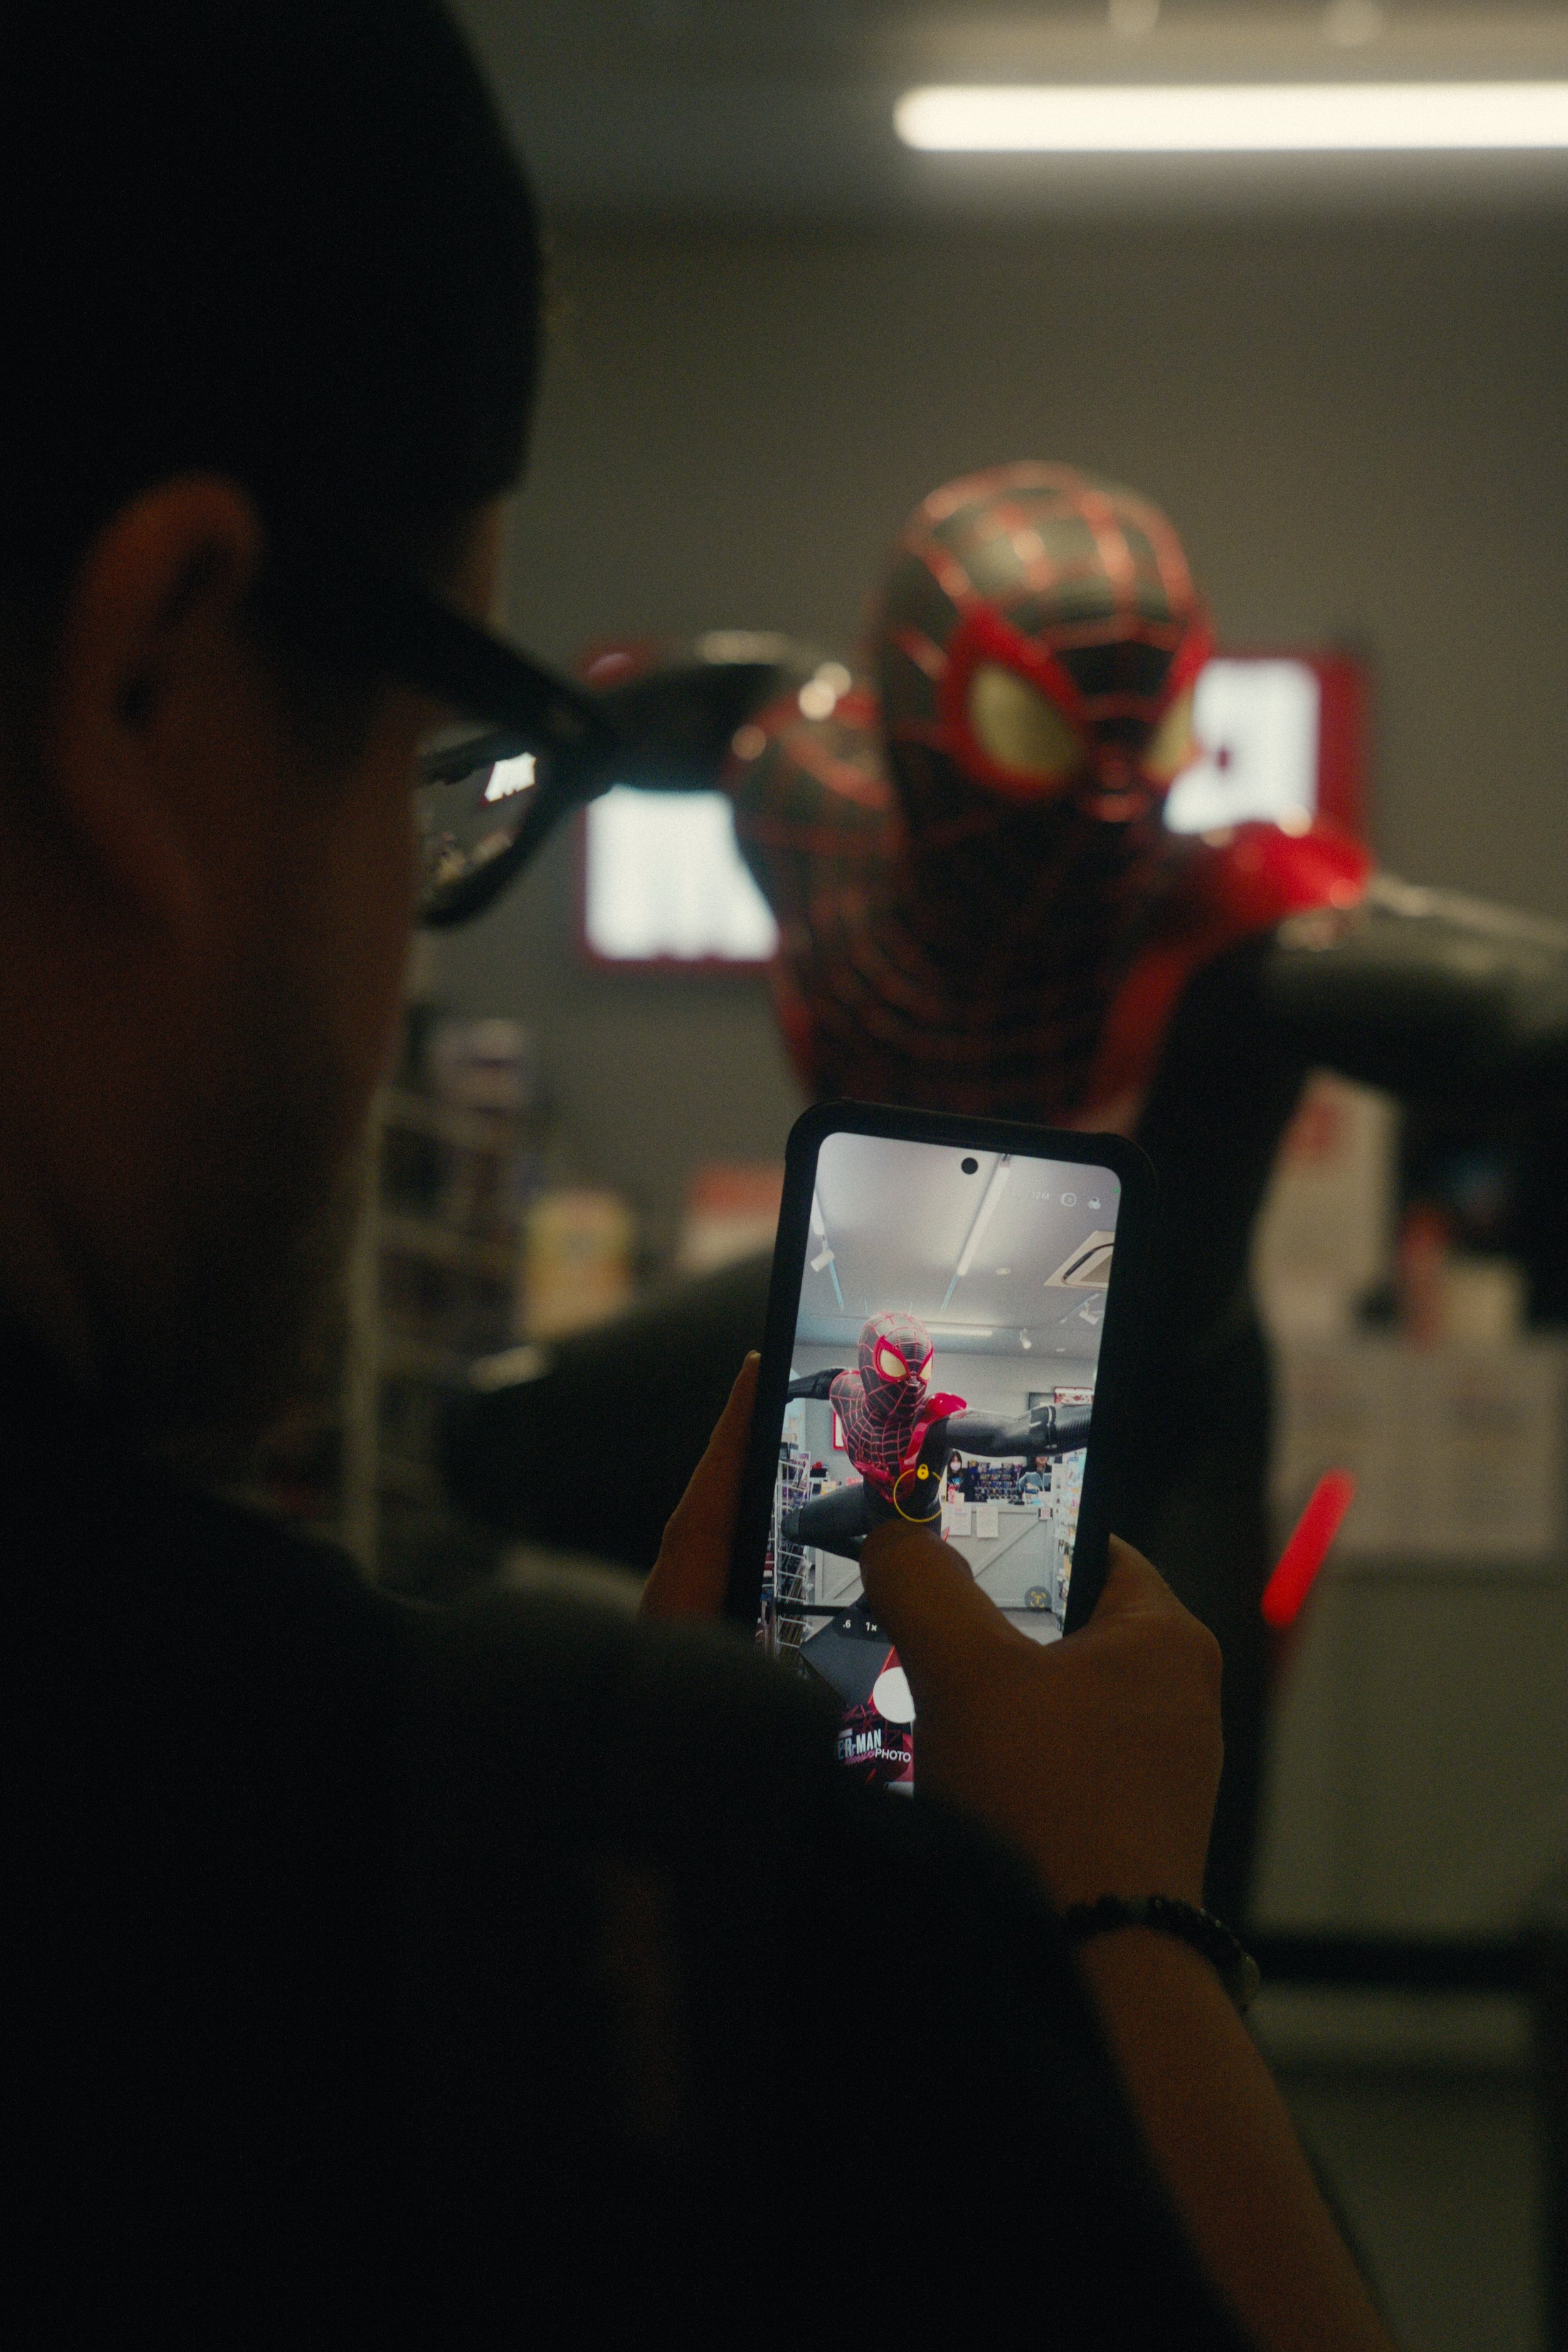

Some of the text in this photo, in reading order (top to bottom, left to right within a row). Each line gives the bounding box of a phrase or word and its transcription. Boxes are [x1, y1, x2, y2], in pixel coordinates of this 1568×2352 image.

[842, 1619, 877, 1631] .6 1x
[837, 1728, 882, 1761] ER-MAN
[875, 1747, 911, 1763] PHOTO
